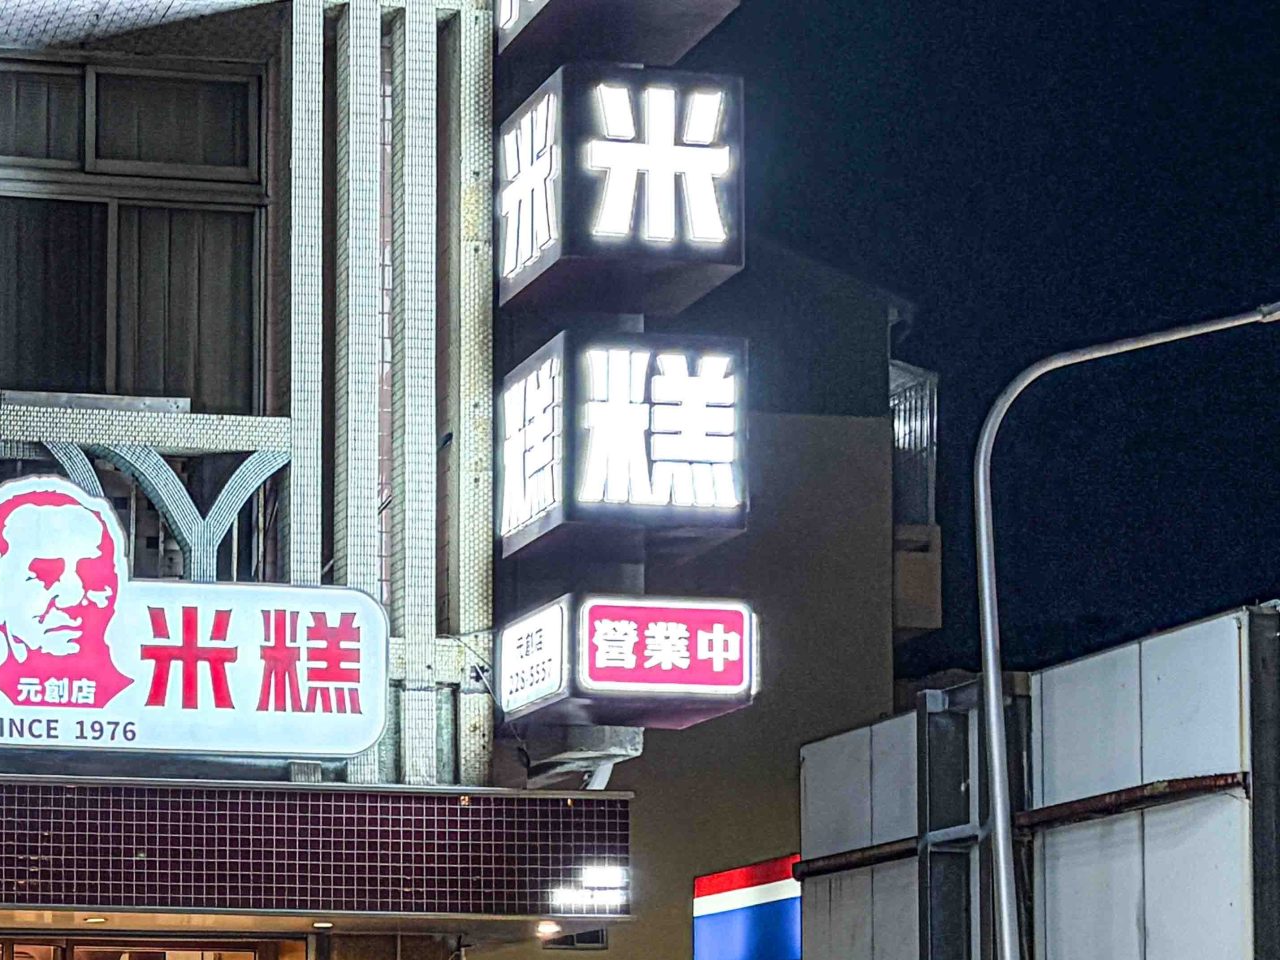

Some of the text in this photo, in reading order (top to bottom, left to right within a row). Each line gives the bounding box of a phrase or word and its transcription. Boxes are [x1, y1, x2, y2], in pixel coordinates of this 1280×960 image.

[140, 605, 362, 714] 米糕
[592, 618, 741, 672] 營業中
[17, 677, 96, 704] 元創店
[75, 720, 137, 742] 1976
